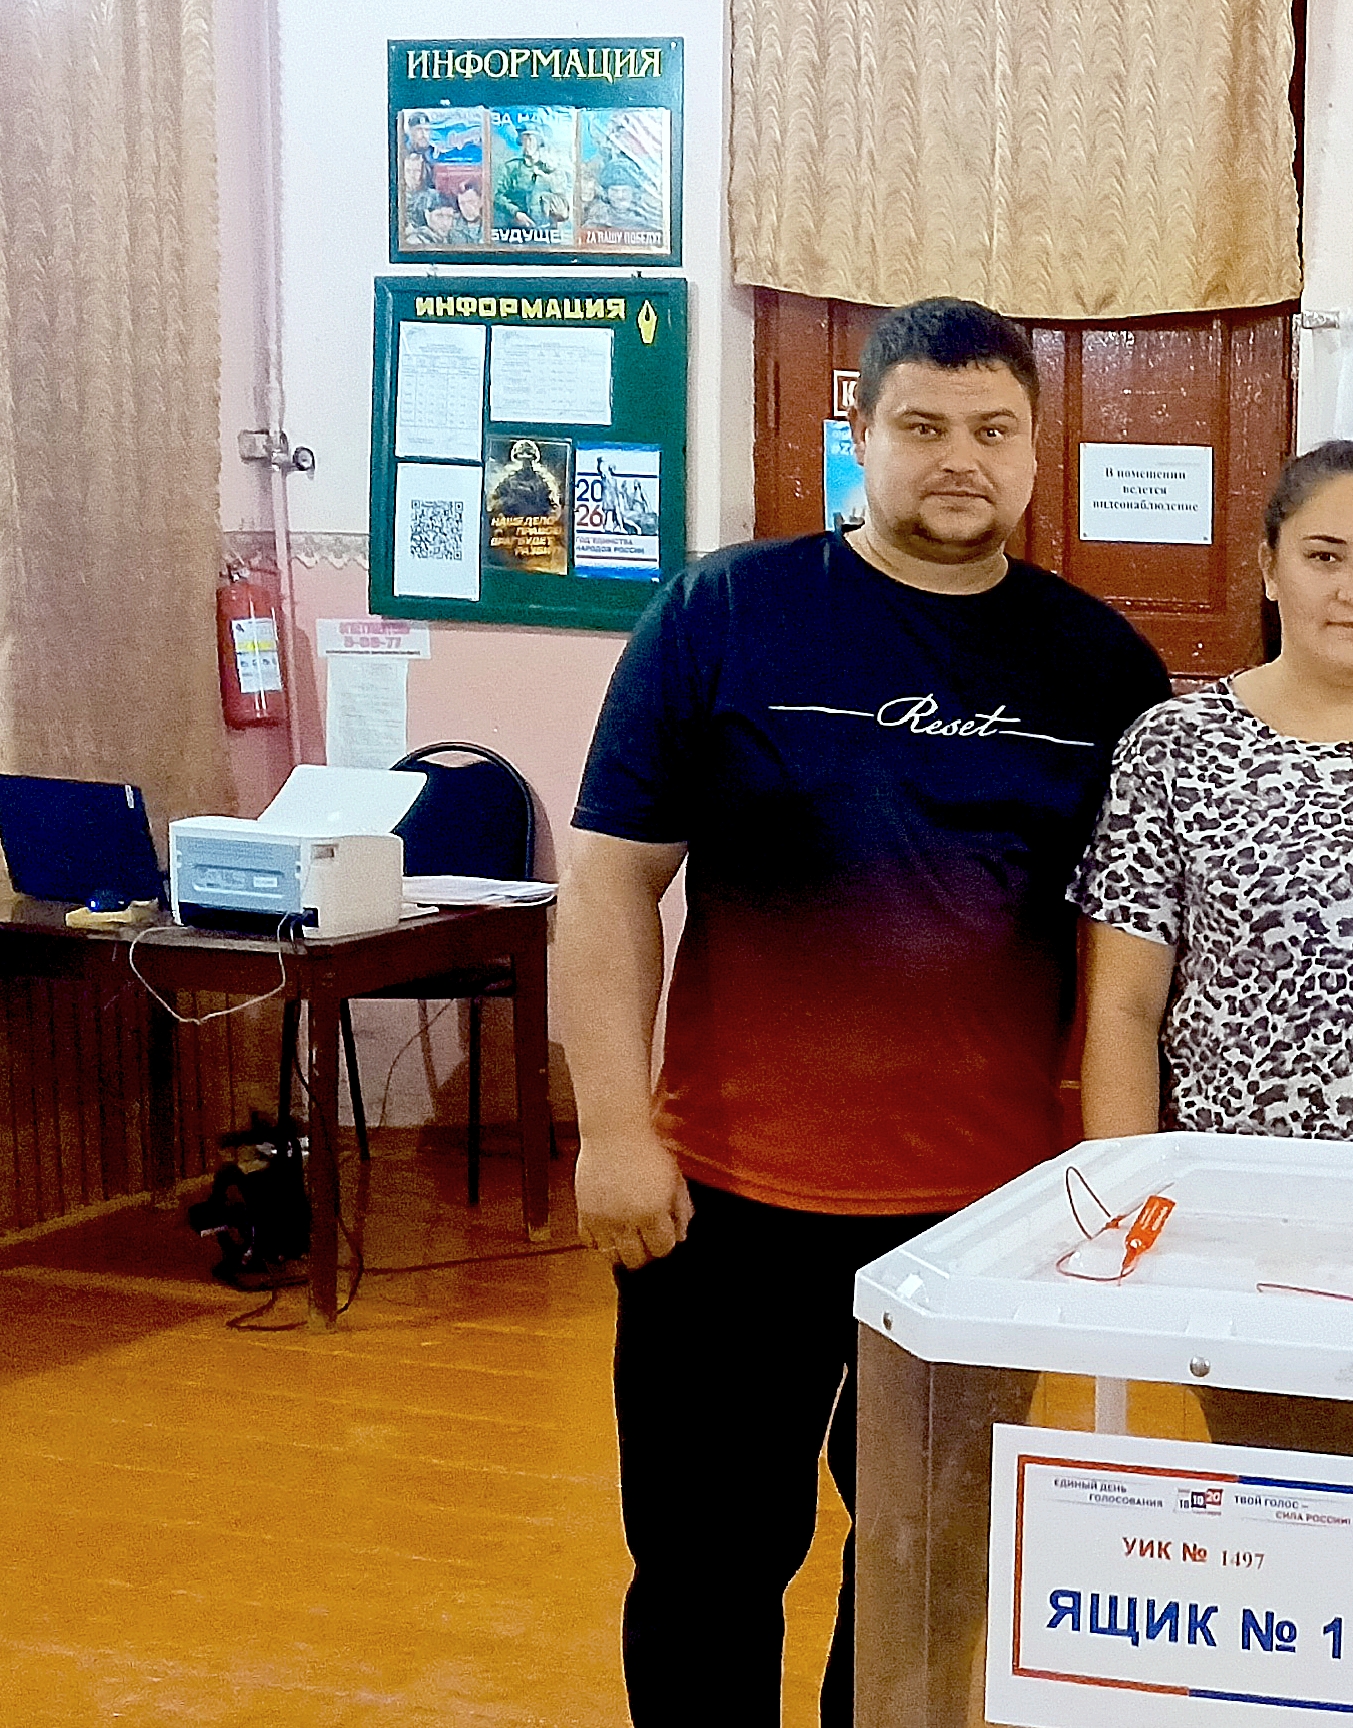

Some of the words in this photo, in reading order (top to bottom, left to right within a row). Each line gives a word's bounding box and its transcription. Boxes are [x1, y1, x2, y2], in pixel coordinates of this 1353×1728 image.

[407, 48, 662, 83] ИНФОРМАЦИЯ
[490, 112, 512, 125] ЗА
[415, 296, 626, 319] ИНФОРМАЦИЯ
[1105, 467, 1113, 477] В
[576, 479, 604, 503] 20
[575, 504, 604, 527] 26
[877, 693, 1021, 737] Reset
[1054, 1479, 1098, 1490] ЕДИНЫЙ
[1100, 1481, 1127, 1493] ДЕНЬ
[1089, 1493, 1163, 1508] ГОЛОСОВАНИЯ
[1206, 1491, 1221, 1503] 20
[1234, 1494, 1262, 1506] ТВОЙ
[1264, 1498, 1300, 1509] ГОЛОС
[1275, 1511, 1303, 1521] СИЛА
[1122, 1536, 1171, 1561] УИК
[1182, 1542, 1208, 1563] №
[1220, 1549, 1265, 1570] 1497
[1047, 1589, 1218, 1647] ЯЩИК
[1242, 1608, 1297, 1653] №
[1323, 1617, 1343, 1660] 1
